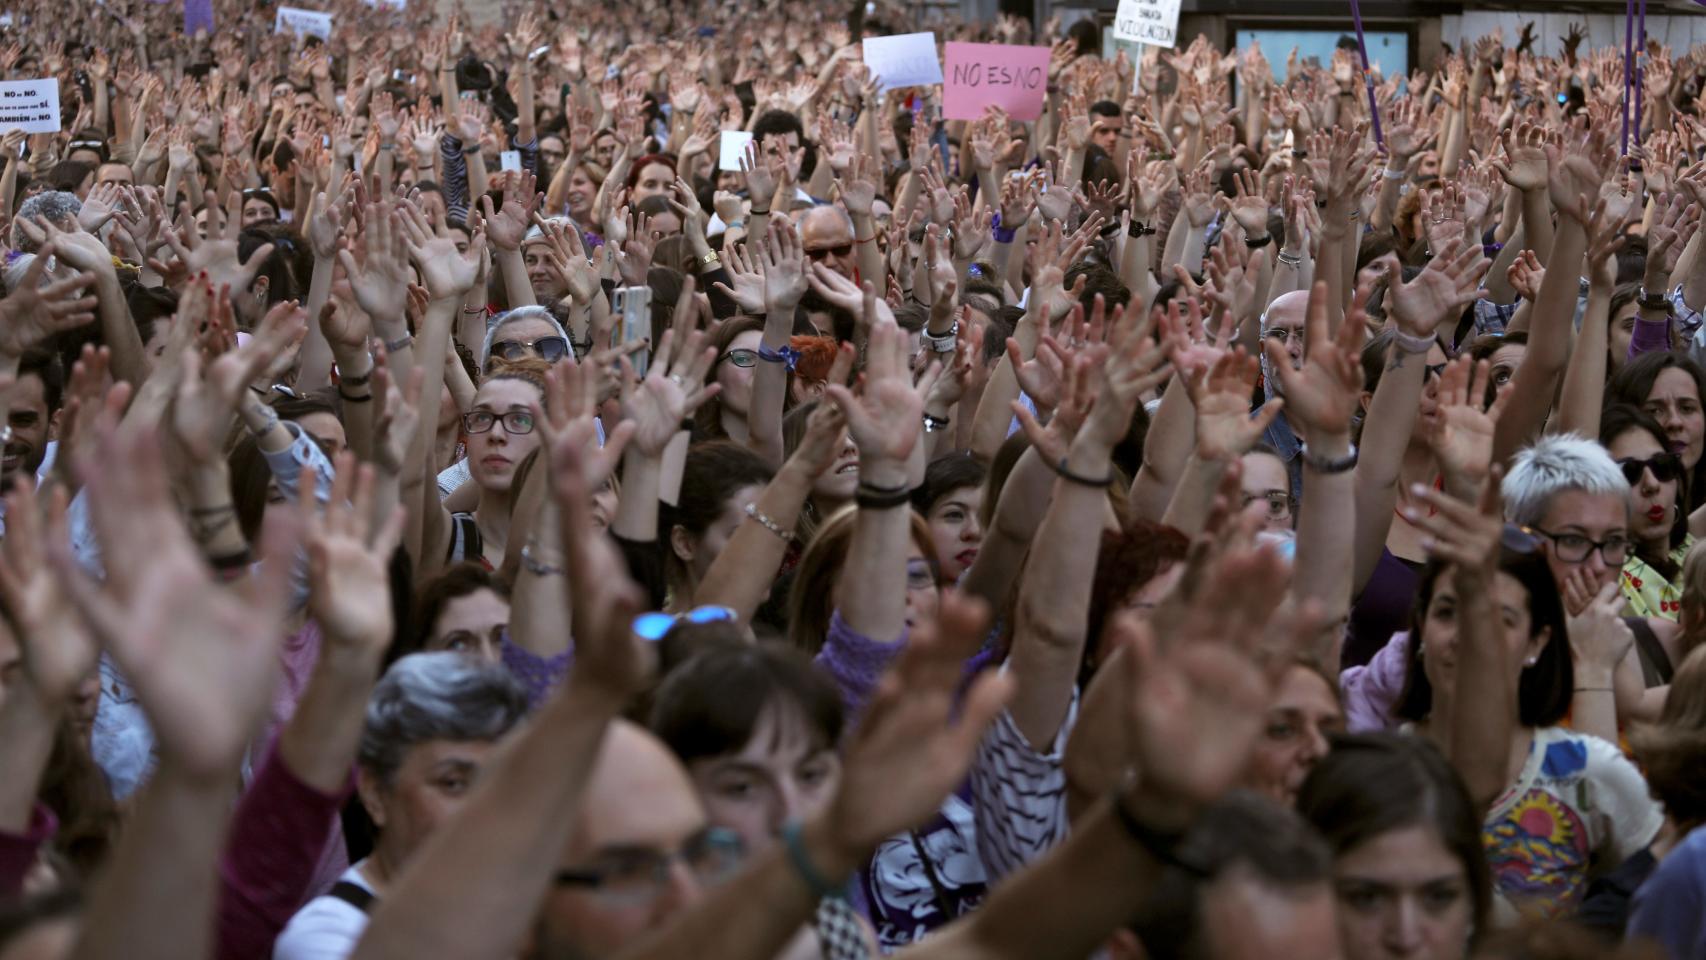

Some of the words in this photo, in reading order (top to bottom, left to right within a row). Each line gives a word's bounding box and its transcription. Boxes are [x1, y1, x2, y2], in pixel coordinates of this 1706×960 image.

[953, 63, 981, 88] NO
[987, 66, 1012, 85] ES
[1013, 66, 1041, 90] NO
